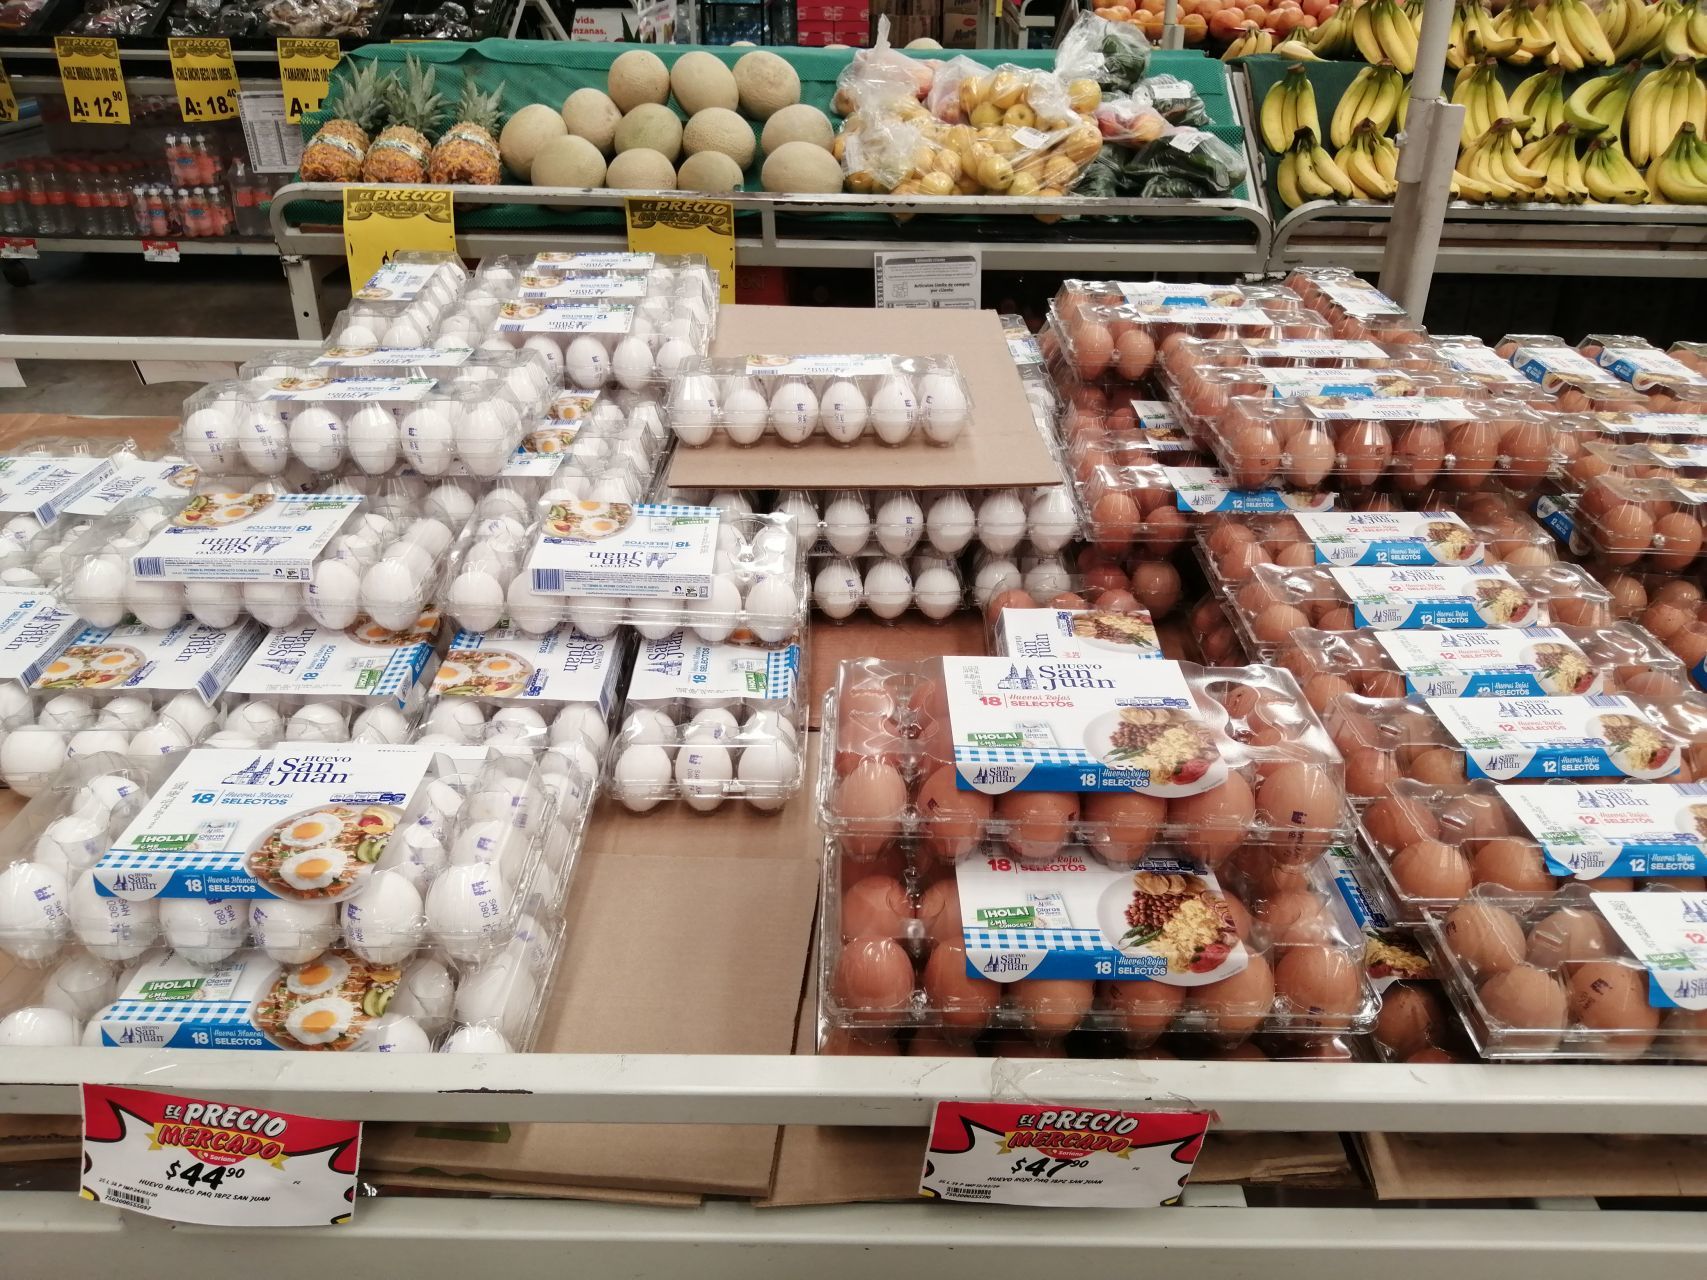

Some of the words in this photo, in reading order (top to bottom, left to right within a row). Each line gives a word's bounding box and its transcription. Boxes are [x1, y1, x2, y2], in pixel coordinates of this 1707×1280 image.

[576, 16, 594, 24] vida
[74, 96, 90, 117] A:
[185, 97, 202, 115] A:
[373, 190, 446, 201] PRECIO
[355, 202, 445, 214] MERCADO
[656, 201, 728, 215] PRECIO
[638, 211, 726, 226] MERCADO
[1232, 500, 1243, 508] 12
[199, 535, 259, 545] Juan
[209, 544, 249, 554] San
[589, 551, 643, 559] Juan
[1376, 552, 1387, 561] 12
[602, 559, 641, 567] San
[18, 599, 36, 609] 18
[1420, 615, 1433, 625] 12
[194, 633, 226, 653] San
[267, 635, 299, 657] San
[288, 628, 317, 657] Juan
[175, 633, 206, 663] Juan
[316, 644, 336, 670] SELECTOS
[564, 643, 583, 672] Juan
[585, 643, 604, 664] San
[1440, 652, 1457, 660] 12
[700, 647, 710, 672] SELECTOS
[302, 672, 319, 681] 18
[1039, 665, 1092, 679] San
[692, 674, 707, 684] 18
[1042, 678, 1116, 691] Juan
[979, 696, 1002, 706] 18
[1515, 700, 1546, 710] San
[1523, 708, 1563, 717] Juan
[1499, 724, 1516, 732] 12
[974, 732, 1017, 740] ¡HOLA!
[1498, 755, 1513, 764] San
[277, 758, 335, 773] San
[1498, 761, 1520, 770] Juan
[1542, 761, 1557, 772] 12
[1561, 764, 1600, 772] SELECTOS
[989, 767, 1009, 777] San
[1079, 774, 1096, 786] 18
[1102, 768, 1129, 777] Huevos
[1130, 768, 1150, 778] Rojos
[268, 772, 349, 786] Juan
[989, 776, 1016, 785] Juan
[1102, 778, 1149, 787] SELECTOS
[192, 793, 216, 804] 18
[1595, 789, 1631, 800] San
[1605, 798, 1649, 809] Juan
[1578, 816, 1600, 825] 12
[141, 834, 190, 843] ¡HOLA!
[1580, 852, 1599, 862] San
[988, 858, 1012, 872] 18
[1020, 864, 1087, 872] SELECTOS
[1580, 859, 1605, 870] Juan
[1629, 858, 1645, 872] 12
[1650, 863, 1696, 871] SELECTOS
[128, 873, 148, 883] San
[130, 882, 157, 891] Juan
[184, 879, 202, 892] 18
[207, 876, 229, 884] Huevos
[231, 876, 258, 884] Blancos
[208, 885, 256, 893] SELECTOS
[225, 905, 237, 922] SAN
[984, 908, 1029, 919] ¡HOLA!
[1000, 954, 1021, 964] San
[1000, 962, 1029, 972] Juan
[1095, 961, 1112, 974] 18
[1118, 956, 1145, 966] Huevos
[1146, 956, 1167, 966] Rojos
[1118, 966, 1166, 975] SELECTOS
[149, 979, 198, 990] ¡HOLA!
[135, 1026, 157, 1036] San
[137, 1035, 164, 1044] Juan
[192, 1032, 209, 1045] 18
[214, 1038, 262, 1046] SELECTOS
[165, 1104, 181, 1119] EL
[183, 1102, 288, 1138] PRECIO
[1020, 1114, 1035, 1125] EL
[1036, 1110, 1139, 1135] PRECIO
[157, 1124, 282, 1160] MERCADO
[1008, 1132, 1130, 1152] MERCADO
[209, 1154, 236, 1163] Soriana
[139, 1178, 164, 1189] HUEVO
[165, 1184, 195, 1195] BLANCO
[197, 1190, 212, 1199] PAQ
